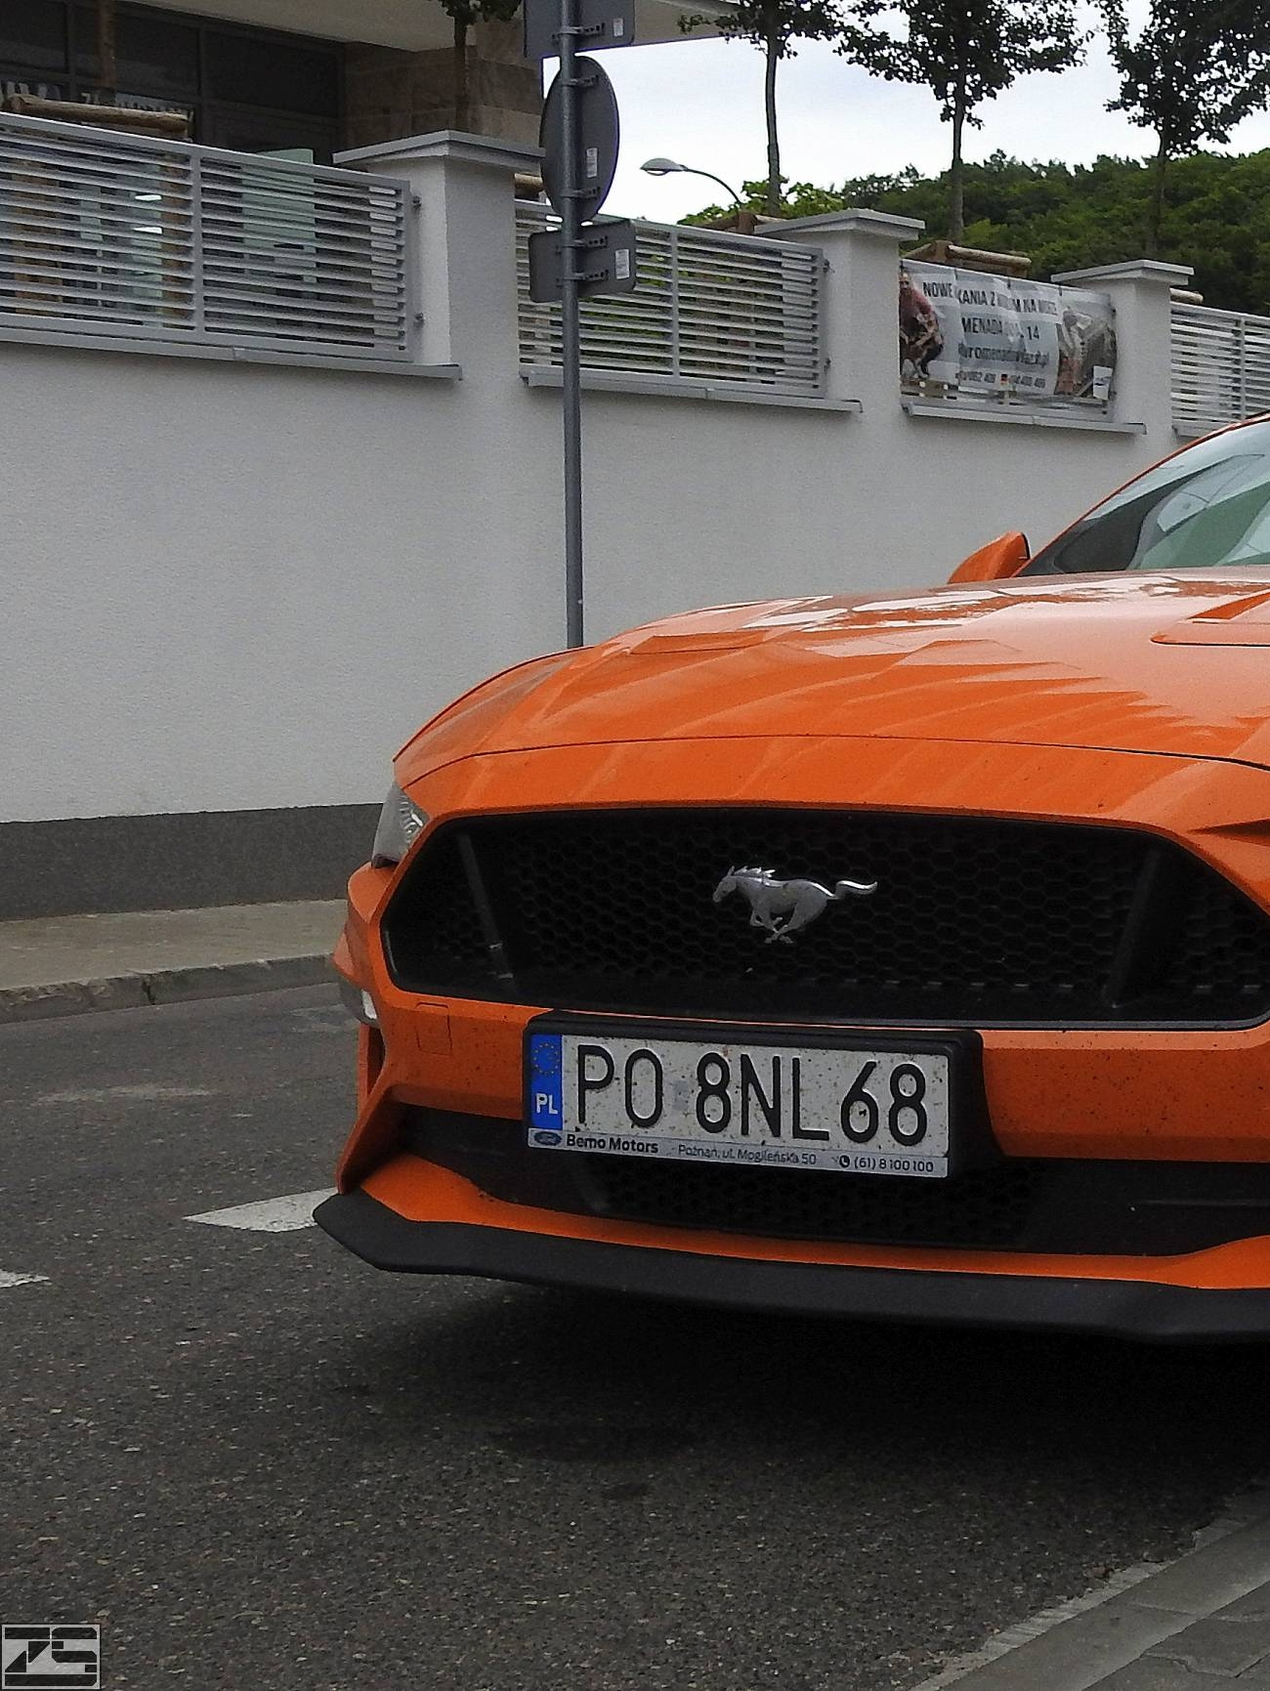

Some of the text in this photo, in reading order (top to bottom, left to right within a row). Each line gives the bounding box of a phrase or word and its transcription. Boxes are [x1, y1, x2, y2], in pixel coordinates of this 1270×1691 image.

[535, 1093, 559, 1115] PL
[576, 1043, 928, 1147] PO 8NL68
[566, 1134, 606, 1149] Bemo
[609, 1137, 659, 1154] Motors
[801, 1152, 817, 1165] 50
[854, 1156, 876, 1170] (61)
